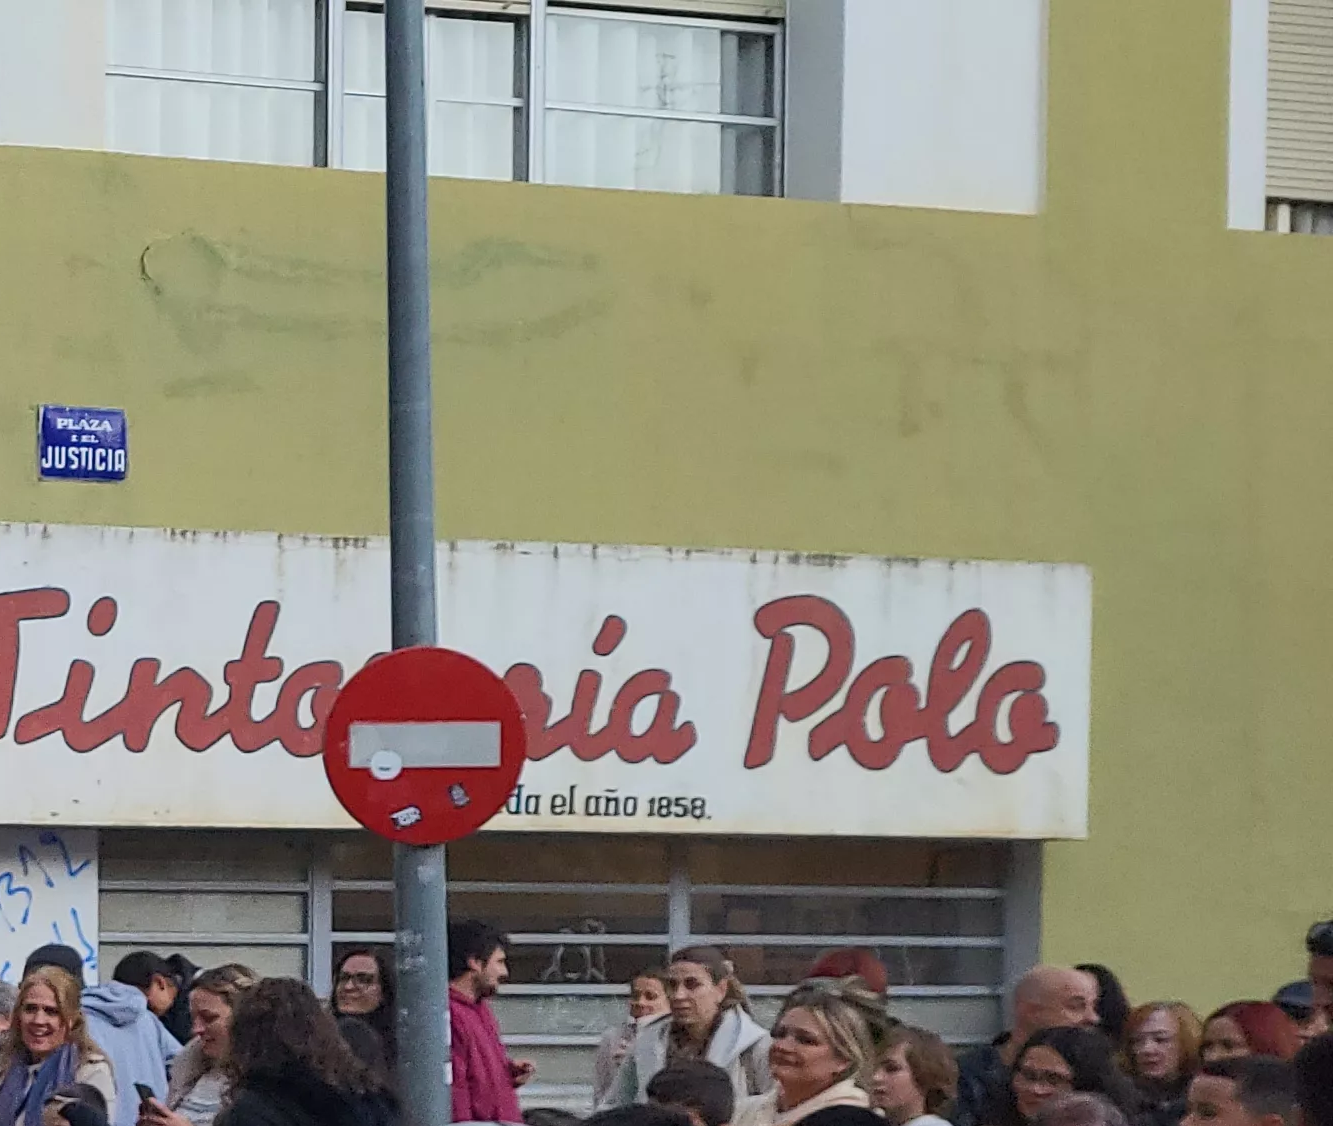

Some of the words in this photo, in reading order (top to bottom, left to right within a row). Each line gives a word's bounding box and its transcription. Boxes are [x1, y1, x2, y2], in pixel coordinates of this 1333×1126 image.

[56, 417, 113, 432] PLAZA
[41, 445, 126, 472] JUSTICIA
[743, 593, 1061, 776] Polo
[549, 784, 577, 816] el
[584, 788, 639, 817] año
[646, 796, 713, 821] 1858.
